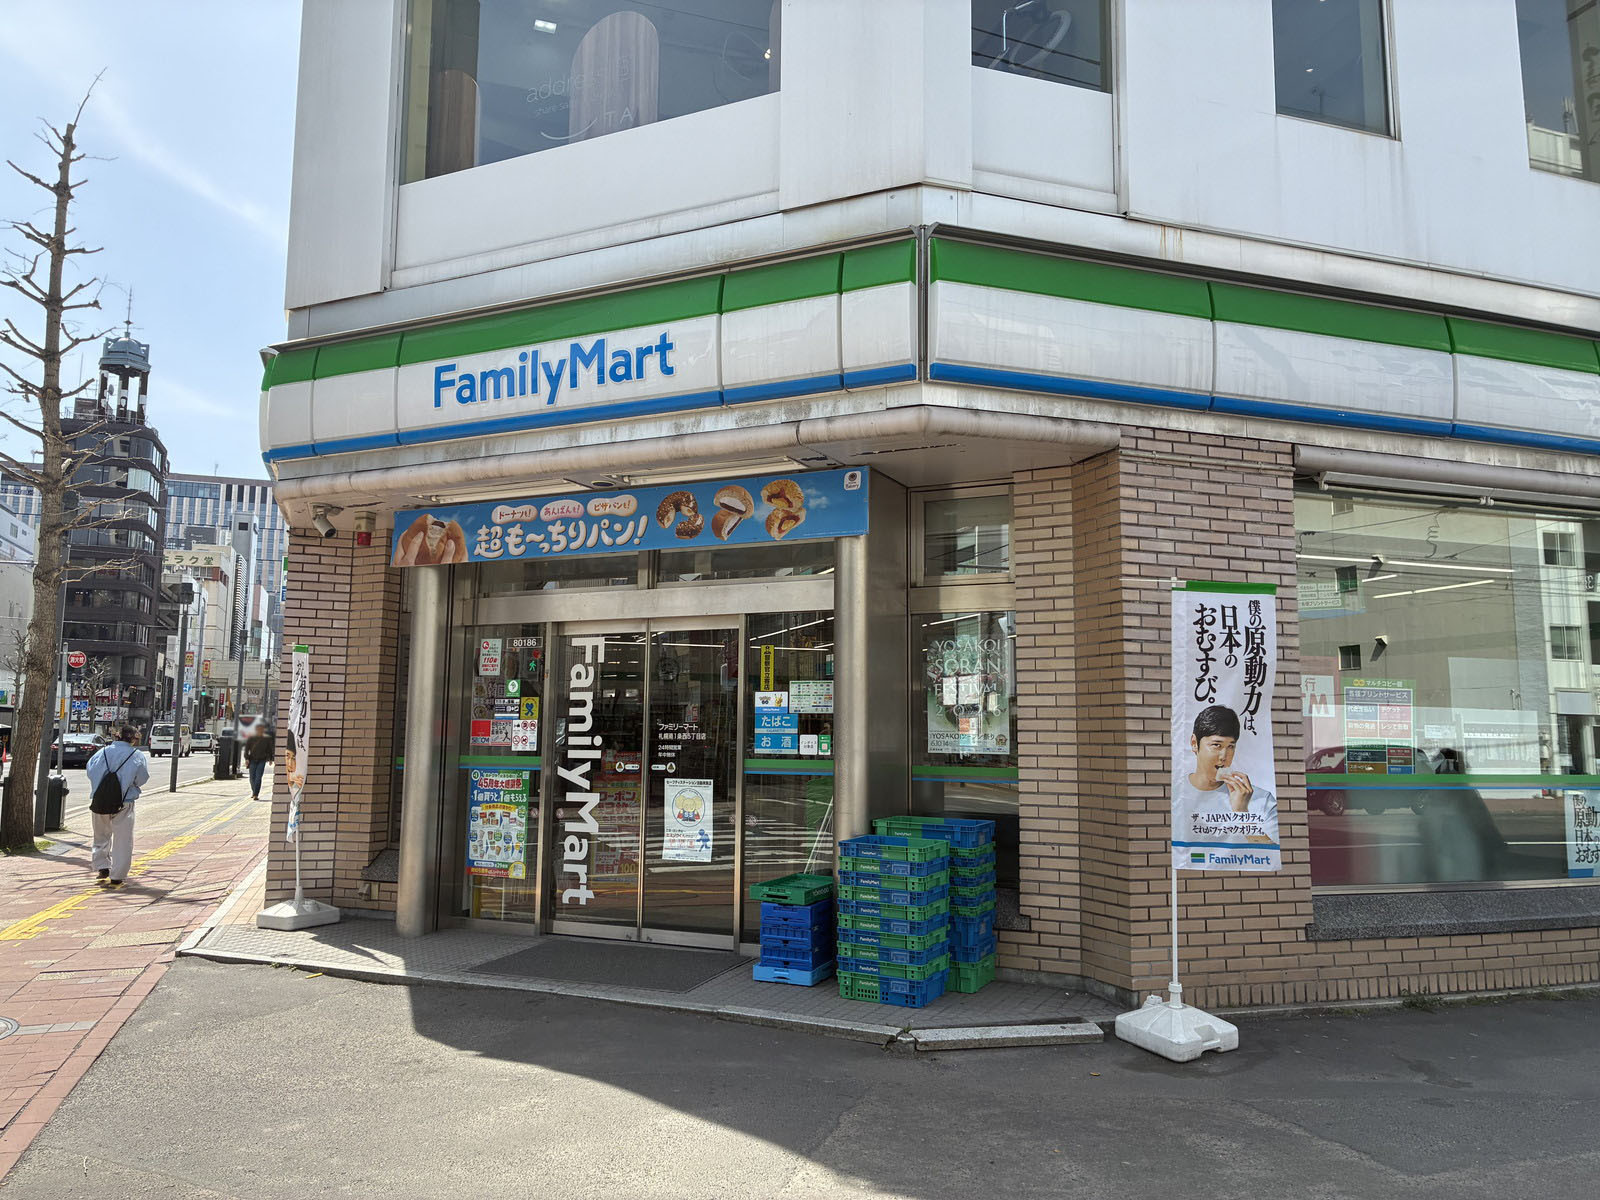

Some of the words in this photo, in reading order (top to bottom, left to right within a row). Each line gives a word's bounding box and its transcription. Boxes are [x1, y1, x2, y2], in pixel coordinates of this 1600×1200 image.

[433, 331, 676, 409] FamilyMart
[513, 638, 537, 647] 80186
[1219, 604, 1243, 669] 日本の
[935, 639, 1001, 653] YOSAKOI
[1192, 602, 1219, 704] おむすび。
[935, 658, 1001, 675] SORAN
[1240, 599, 1268, 736] 僕の原動力は、
[658, 723, 699, 731] ファミリーマート
[761, 715, 791, 727] たばこ
[556, 636, 606, 906] FamilyMart
[1191, 812, 1265, 823] ザ・JAPANクオリティ。
[1192, 825, 1265, 836] それがファミマクオリティ。
[1575, 829, 1600, 847] 日本の
[1209, 853, 1271, 866] FamilyMart
